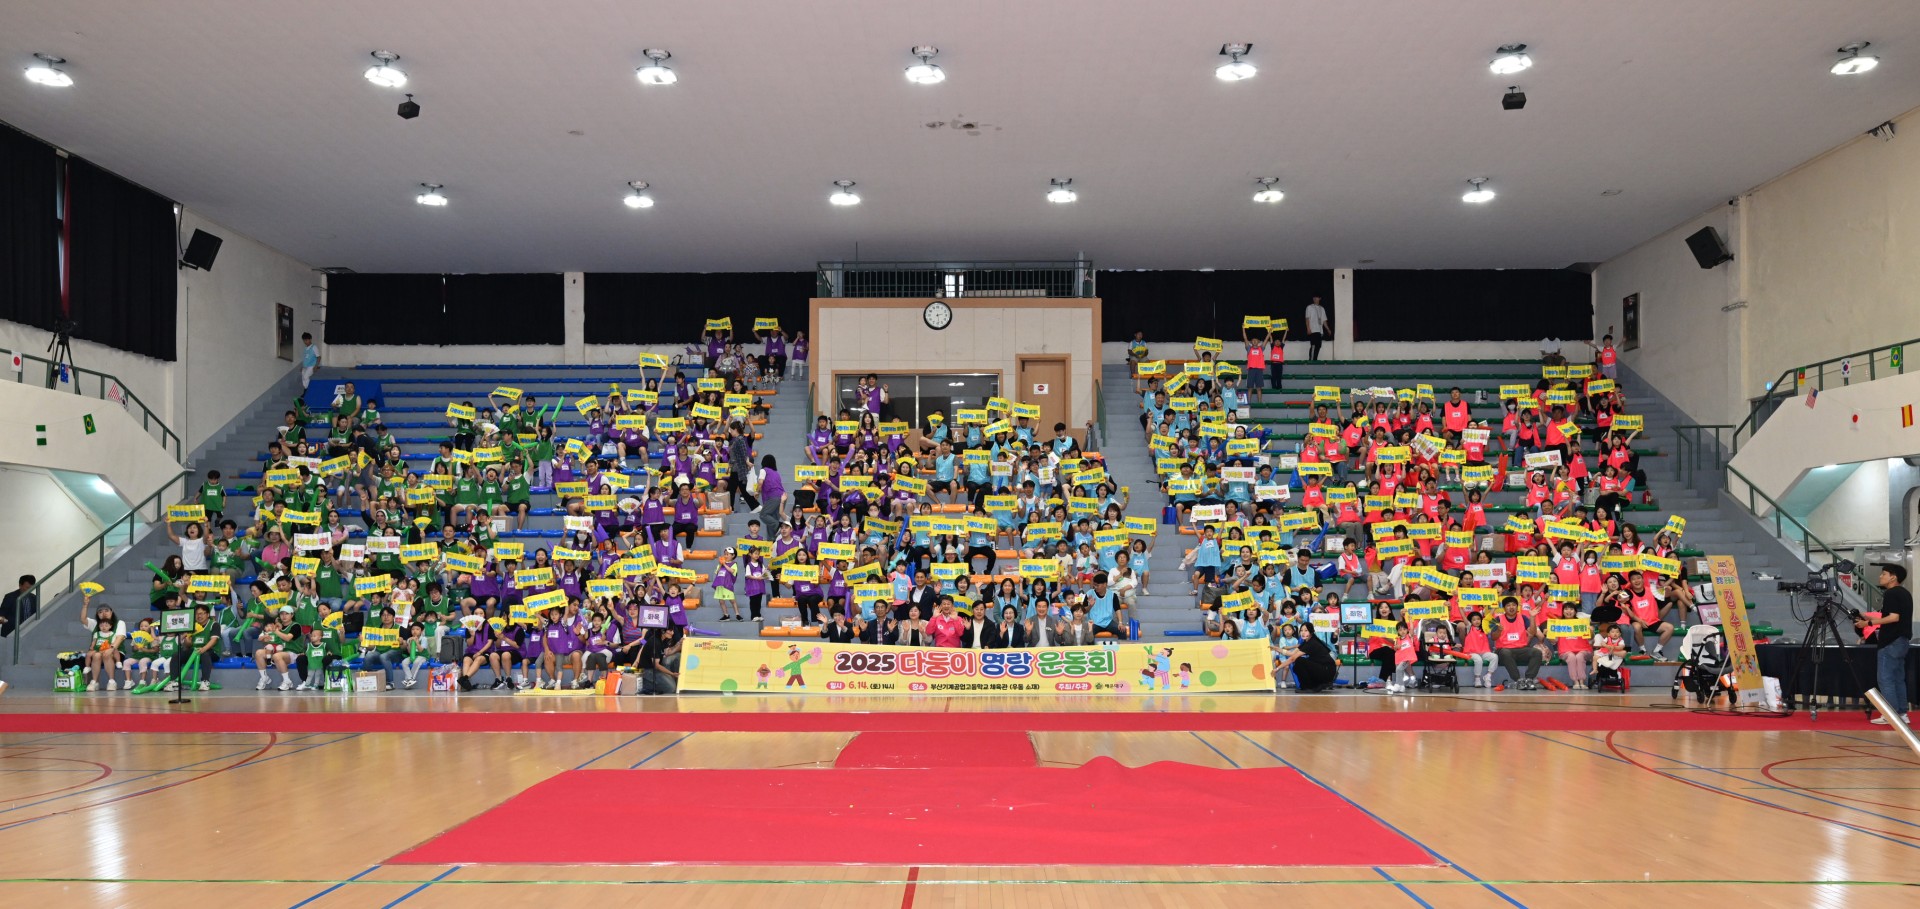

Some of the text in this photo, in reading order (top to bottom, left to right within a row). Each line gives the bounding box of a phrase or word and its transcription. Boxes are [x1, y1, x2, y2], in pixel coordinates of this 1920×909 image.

[171, 617, 184, 625] 행복
[836, 651, 1114, 676] 2025 다둥이 명랑 운동회
